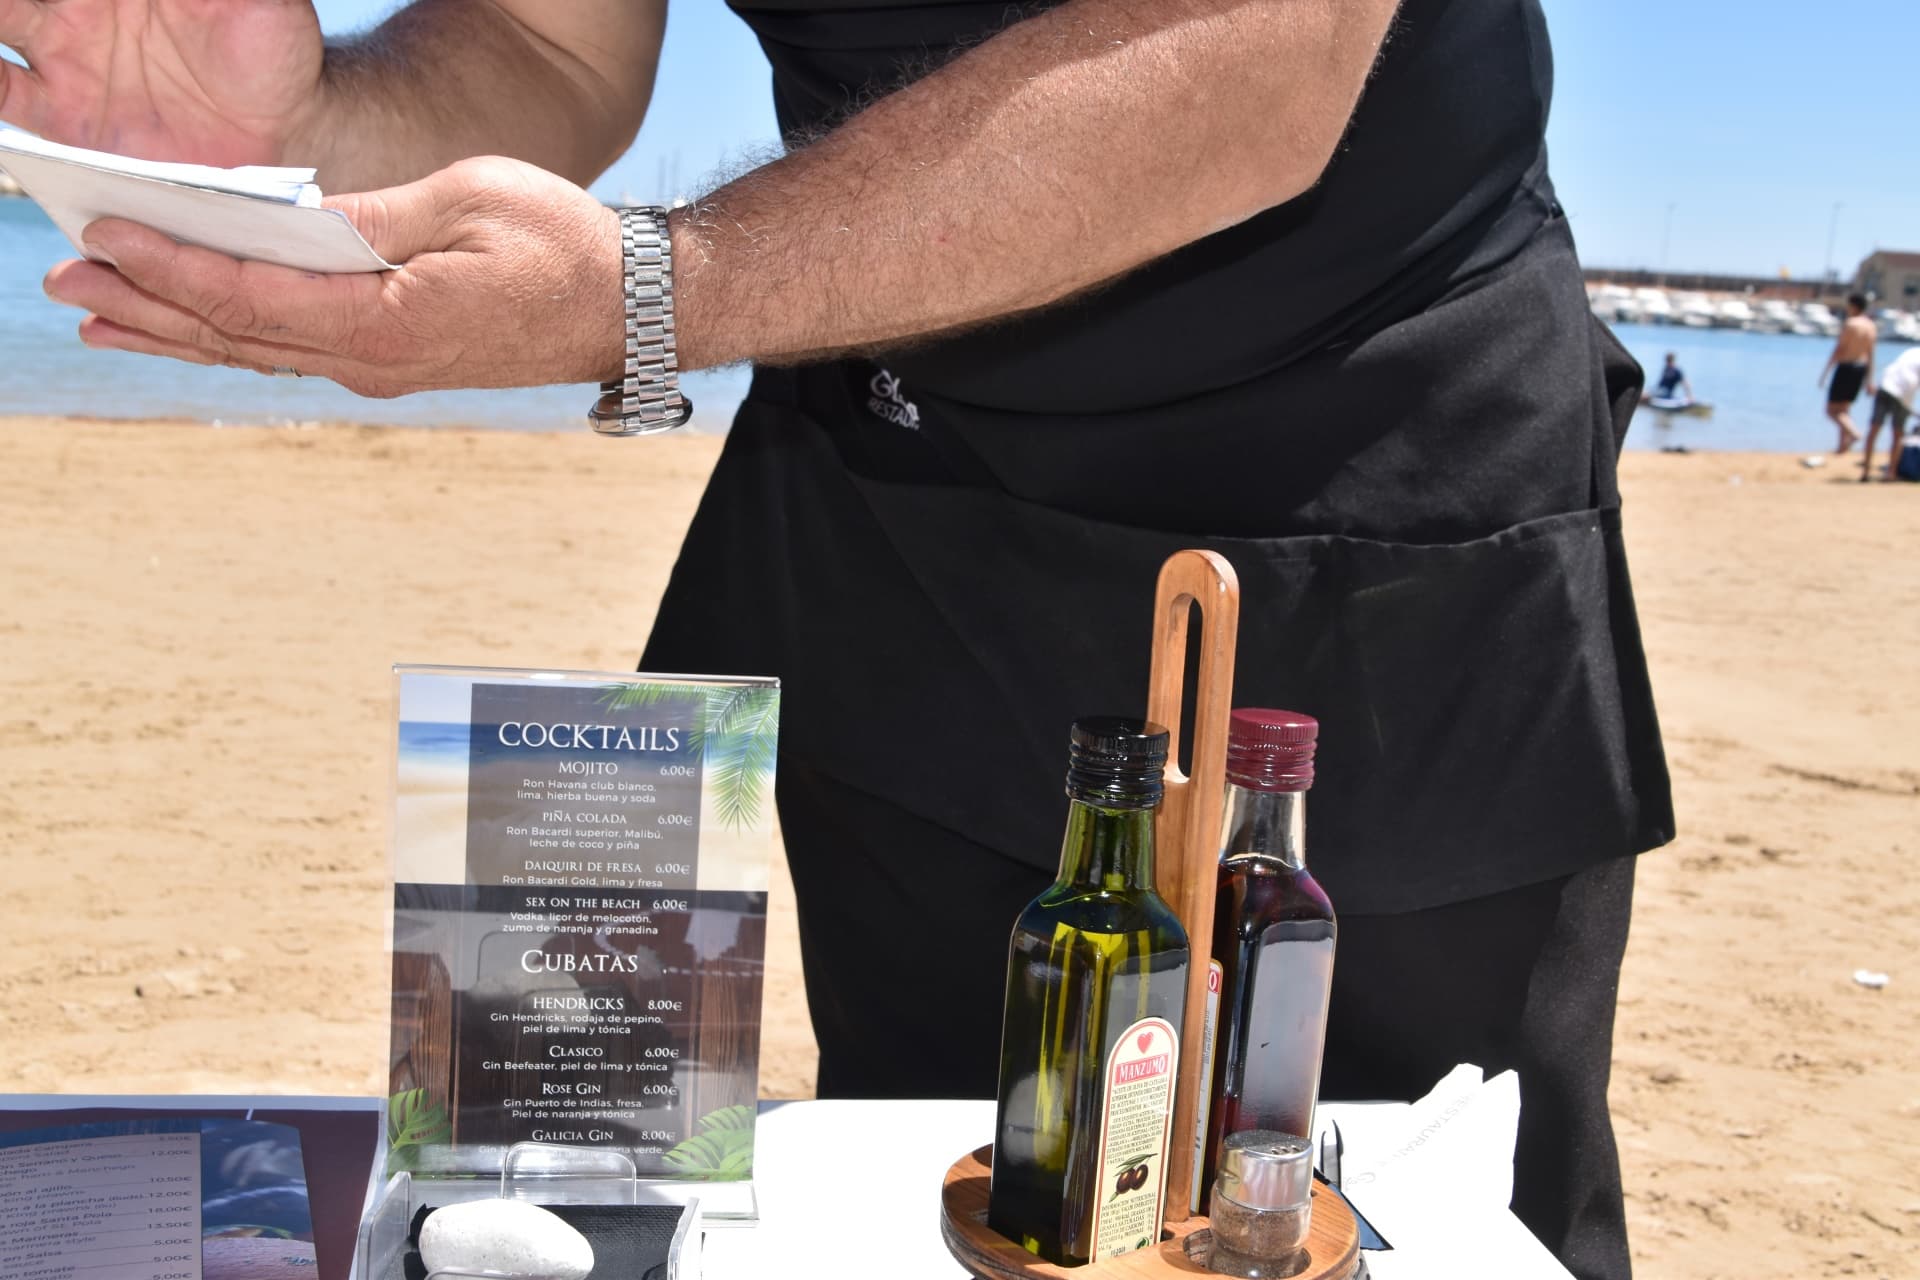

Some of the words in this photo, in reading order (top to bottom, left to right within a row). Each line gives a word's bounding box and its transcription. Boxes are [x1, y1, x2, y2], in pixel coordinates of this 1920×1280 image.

[498, 721, 680, 752] COCKTAILS
[559, 761, 618, 776] MOJITO
[660, 766, 695, 777] 6.00€
[523, 779, 544, 788] Ron
[548, 780, 588, 789] Havana
[591, 781, 614, 790] club
[518, 791, 543, 800] lima,
[547, 791, 581, 801] hierba
[585, 792, 618, 802] buena
[622, 795, 627, 804] y
[630, 794, 656, 803] soda
[543, 810, 571, 823] PIÑA
[576, 814, 627, 824] COLADA
[658, 815, 693, 825] 6.00€
[507, 827, 527, 836] Ron
[575, 828, 622, 839] superior,
[625, 829, 663, 839] Malibú,
[529, 838, 558, 848] leche
[562, 839, 575, 848] de
[607, 841, 613, 850] y
[616, 840, 639, 851] piña
[525, 861, 582, 872] DAIQUIRI
[587, 862, 602, 872] DE
[607, 863, 641, 872] FRESA
[656, 864, 690, 875] 6.00€
[503, 876, 524, 885] Ron
[571, 877, 599, 887] Gold,
[602, 878, 625, 887] lima
[629, 880, 634, 889] y
[638, 878, 663, 888] fresa
[526, 898, 546, 907] SEX
[550, 898, 570, 907] ON
[575, 898, 597, 908] THE
[602, 899, 640, 909] BEACH
[653, 900, 687, 910] 6.00€
[511, 912, 546, 921] Vodka,
[549, 913, 572, 921] licor
[575, 913, 589, 922] de
[536, 924, 550, 932] de
[554, 925, 593, 934] naranja
[595, 927, 601, 935] y
[605, 926, 658, 935] granadina
[533, 997, 624, 1010] HENDRICKS
[648, 1001, 682, 1011] 8.00€
[490, 1013, 508, 1022] Gin
[512, 1013, 567, 1023] Hendricks,
[571, 1014, 604, 1023] rodaja
[607, 1015, 621, 1023] de
[624, 1015, 663, 1024] pepino,
[523, 1025, 543, 1034] piel
[563, 1025, 586, 1034] lima
[589, 1027, 595, 1035] y
[598, 1025, 631, 1034] tónica
[549, 1045, 603, 1057] CLASICO
[645, 1048, 679, 1058] 6.00€
[483, 1061, 501, 1070] Gin
[504, 1061, 556, 1071] Beefeater,
[561, 1062, 580, 1071] piel
[584, 1062, 597, 1070] de
[601, 1062, 623, 1071] lima
[627, 1064, 632, 1072] y
[636, 1062, 668, 1071] tónica
[1118, 1056, 1166, 1082] MANZUMO
[542, 1083, 572, 1094] ROSE
[576, 1083, 601, 1094] GIN
[643, 1085, 677, 1095] 6.00€
[504, 1099, 521, 1107] Gin
[525, 1099, 559, 1108] Puerto
[563, 1099, 577, 1108] de
[580, 1099, 614, 1109] Indias,
[617, 1099, 644, 1108] fresa,
[512, 1110, 532, 1118] Piel
[535, 1110, 549, 1118] de
[552, 1111, 590, 1120] naranja
[593, 1112, 599, 1121] y
[603, 1110, 635, 1119] tónica
[532, 1130, 584, 1141] GALICIA
[589, 1130, 614, 1141] GIN
[641, 1131, 675, 1141] 8.00€
